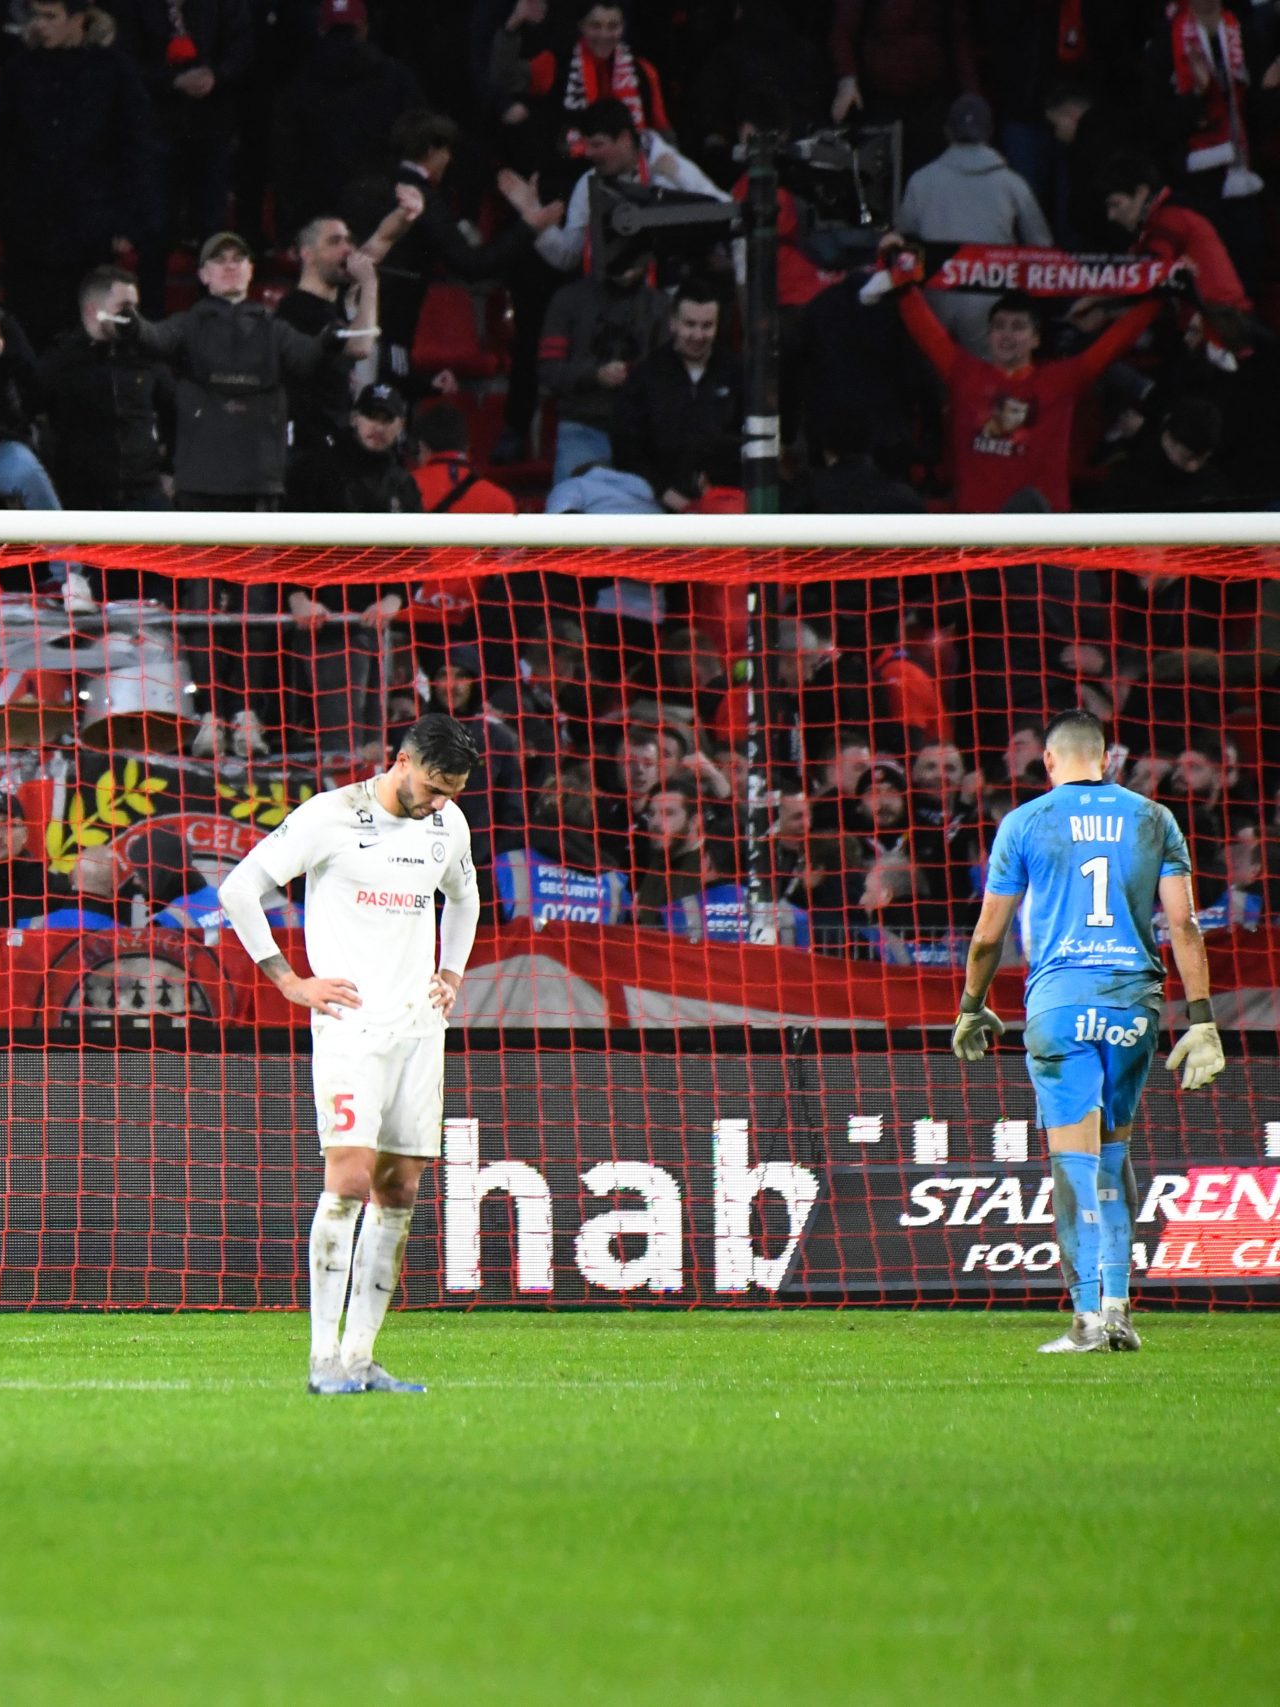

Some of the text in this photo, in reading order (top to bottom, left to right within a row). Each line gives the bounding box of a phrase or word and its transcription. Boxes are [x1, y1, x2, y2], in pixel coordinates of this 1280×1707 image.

[942, 258, 1018, 289] STADE
[1027, 261, 1141, 289] RENNAIS
[1070, 815, 1124, 843] RULLI
[539, 881, 605, 898] SECURITY
[1079, 855, 1115, 928] 1
[333, 1093, 356, 1132] 5
